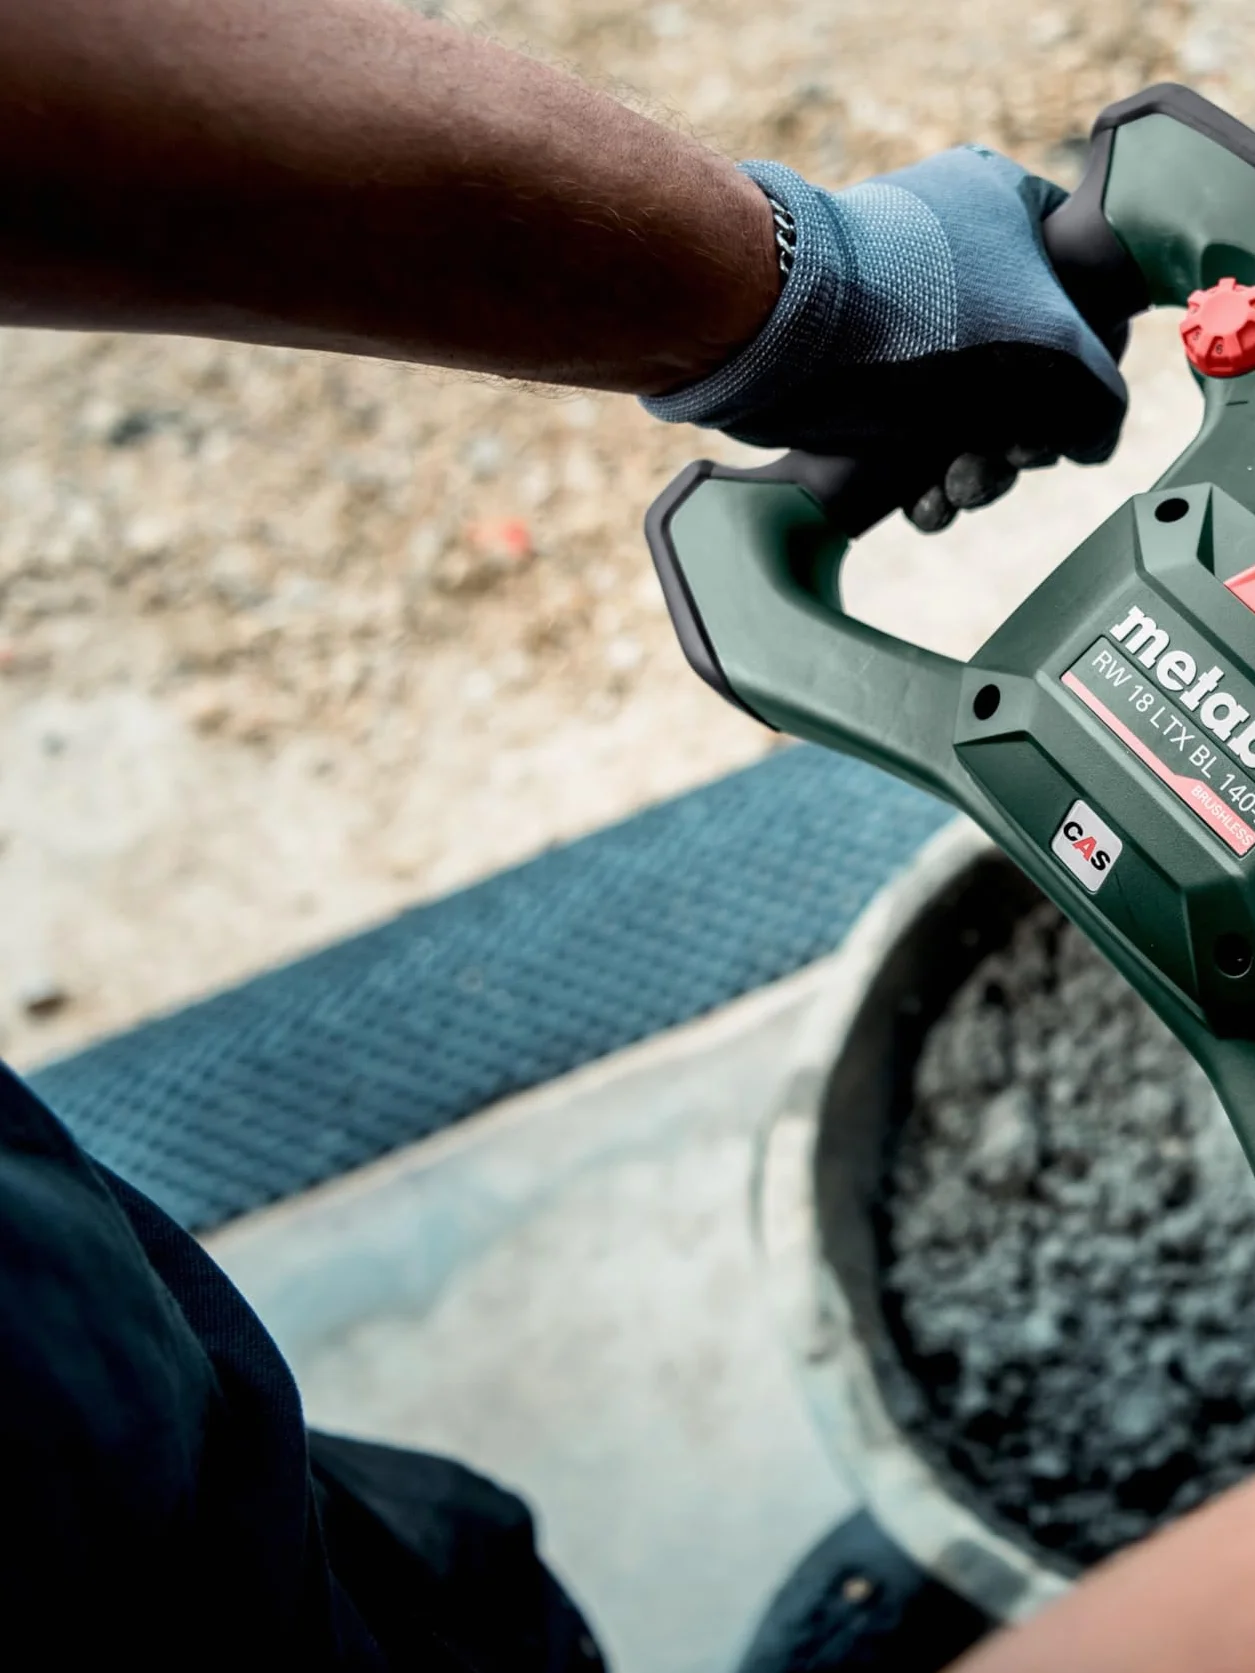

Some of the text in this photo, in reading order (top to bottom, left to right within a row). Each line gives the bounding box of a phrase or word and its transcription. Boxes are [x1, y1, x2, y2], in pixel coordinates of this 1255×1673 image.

[1091, 650, 1132, 688] RW
[1128, 685, 1155, 713] 18
[1150, 706, 1195, 751] LTX
[1189, 744, 1219, 779] BL
[1063, 821, 1111, 871] CAS
[1191, 784, 1253, 848] BRUSHLESS
